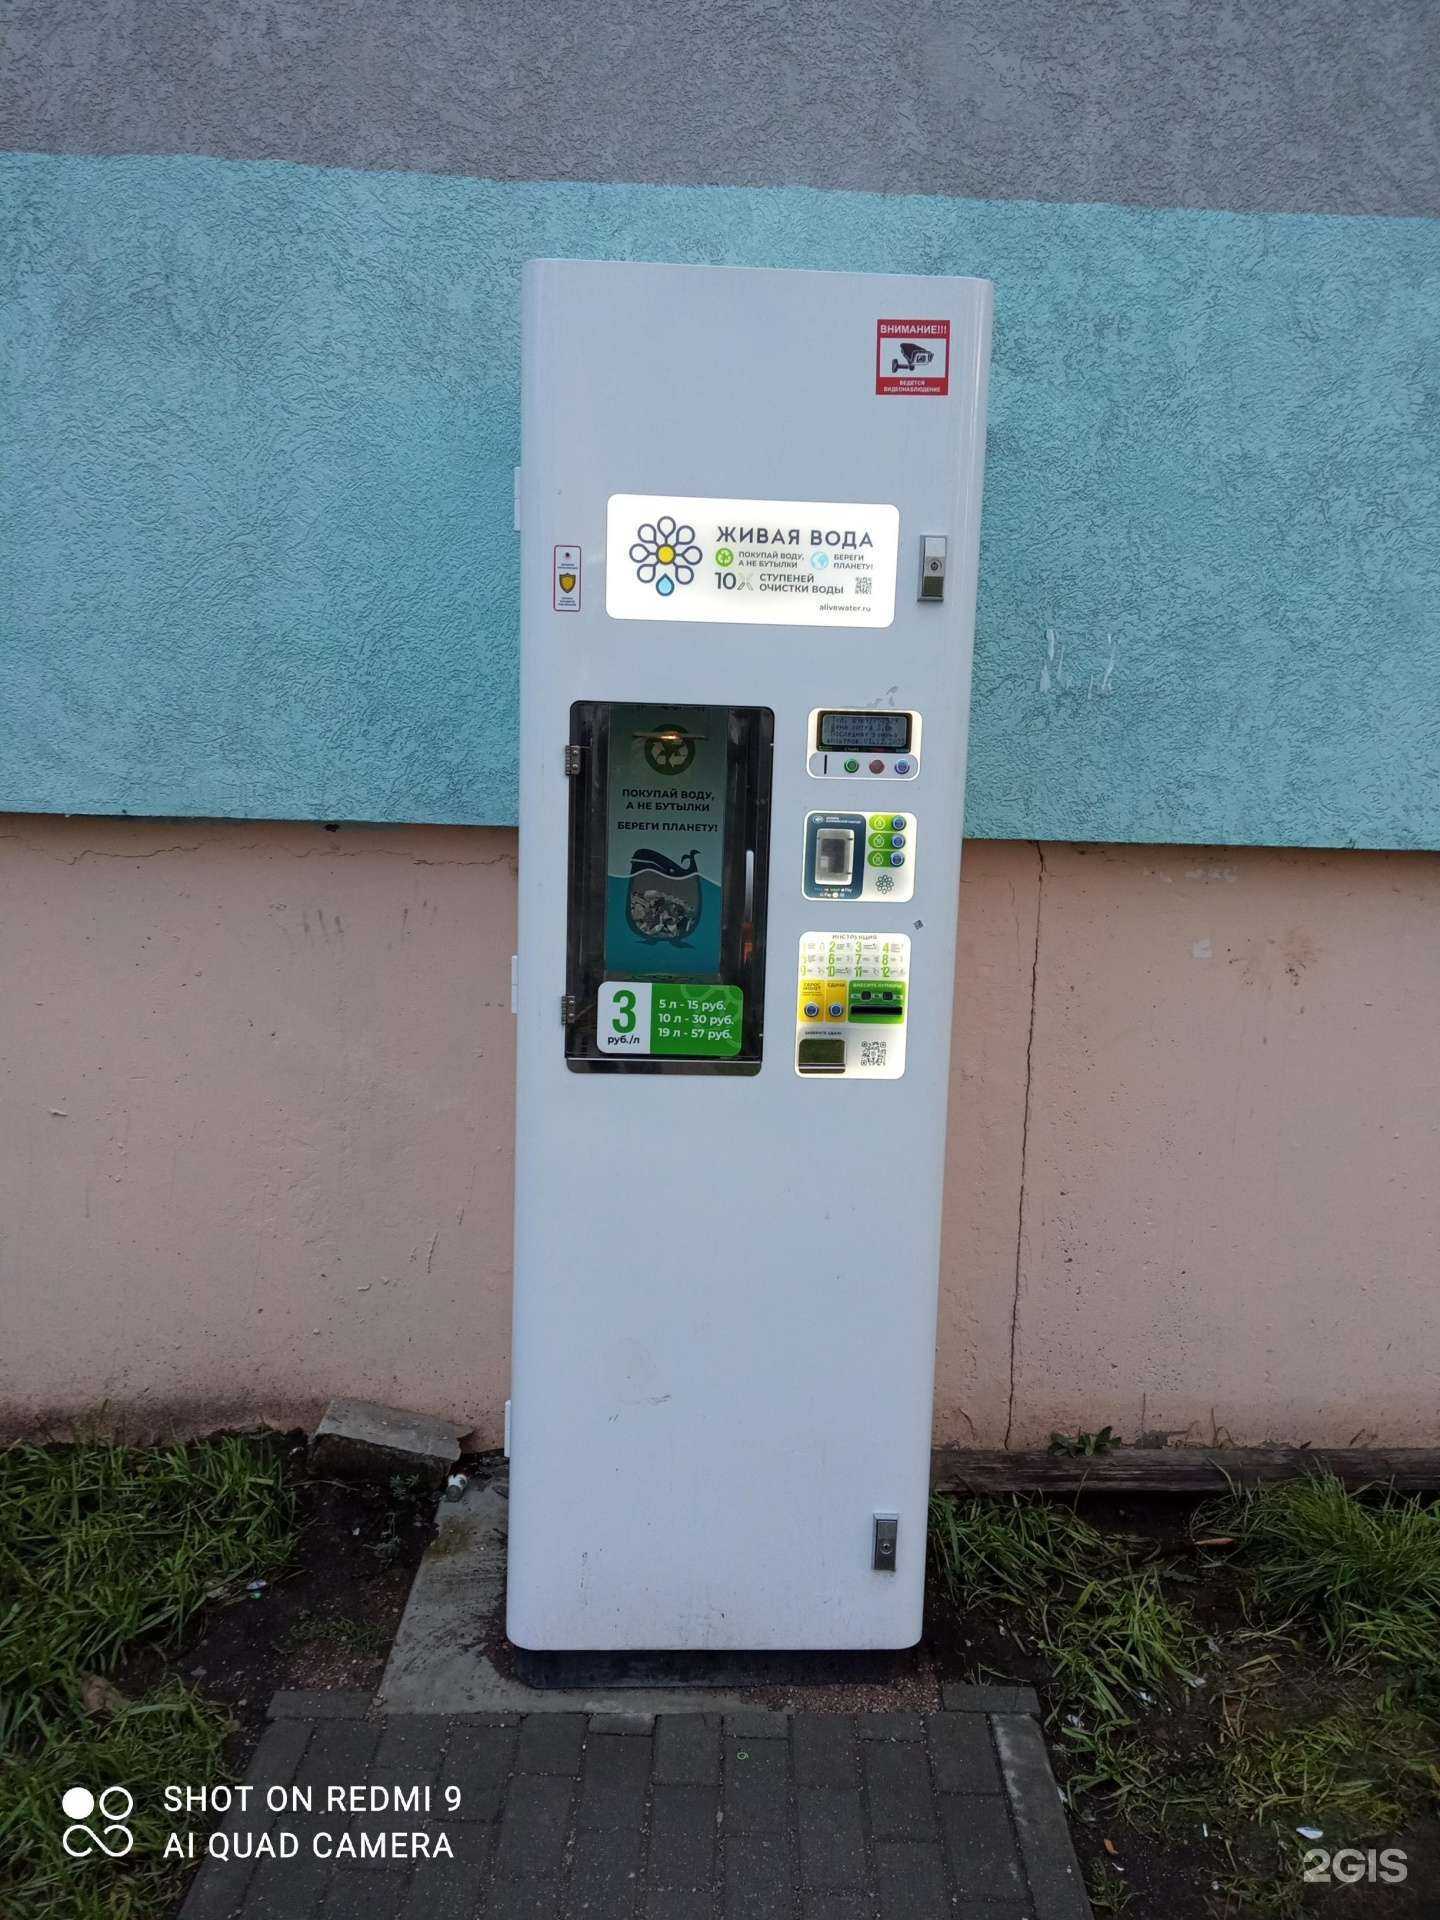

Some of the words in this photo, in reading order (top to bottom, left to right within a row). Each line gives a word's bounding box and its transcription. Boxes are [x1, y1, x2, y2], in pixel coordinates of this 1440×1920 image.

[880, 324, 947, 334] ВНИМАНИЕ!!!
[716, 526, 800, 545] ЖИВАЯ
[811, 530, 873, 549] ВОДА
[738, 551, 779, 560] ПОКУПАЙ
[780, 552, 805, 561] ВОДУ,
[833, 553, 864, 562] БЕРЕГИ
[758, 560, 798, 569] БУТЫЛКИ
[833, 562, 874, 571] ПЛАНЕТУ!
[759, 573, 815, 583] СТУПЕНЕЙ
[759, 584, 809, 594] ОЧИСТКИ
[812, 585, 844, 595] ВОДЫ
[819, 603, 871, 612] alivewater.ru
[622, 788, 677, 799] ПОКУПАЙ
[681, 790, 715, 801] ВОДУ,
[626, 802, 634, 810] А
[638, 802, 652, 810] НЕ
[655, 802, 710, 812] БУТЫЛКИ
[617, 821, 659, 831] БЕРЕГИ
[663, 822, 718, 833] ПЛАНЕТУ!
[612, 990, 637, 1034] 3
[659, 1000, 666, 1009] 5
[669, 1001, 677, 1009] л
[688, 1001, 699, 1010] 15
[702, 1001, 726, 1013] руб.
[659, 1014, 670, 1023] 10
[673, 1016, 681, 1024] л
[692, 1015, 707, 1024] 30
[709, 1015, 734, 1027] руб.
[658, 1028, 670, 1037] 19
[673, 1030, 681, 1038] л
[691, 1029, 705, 1038] 57
[708, 1029, 733, 1040] руб.
[607, 1034, 640, 1046] руб./л
